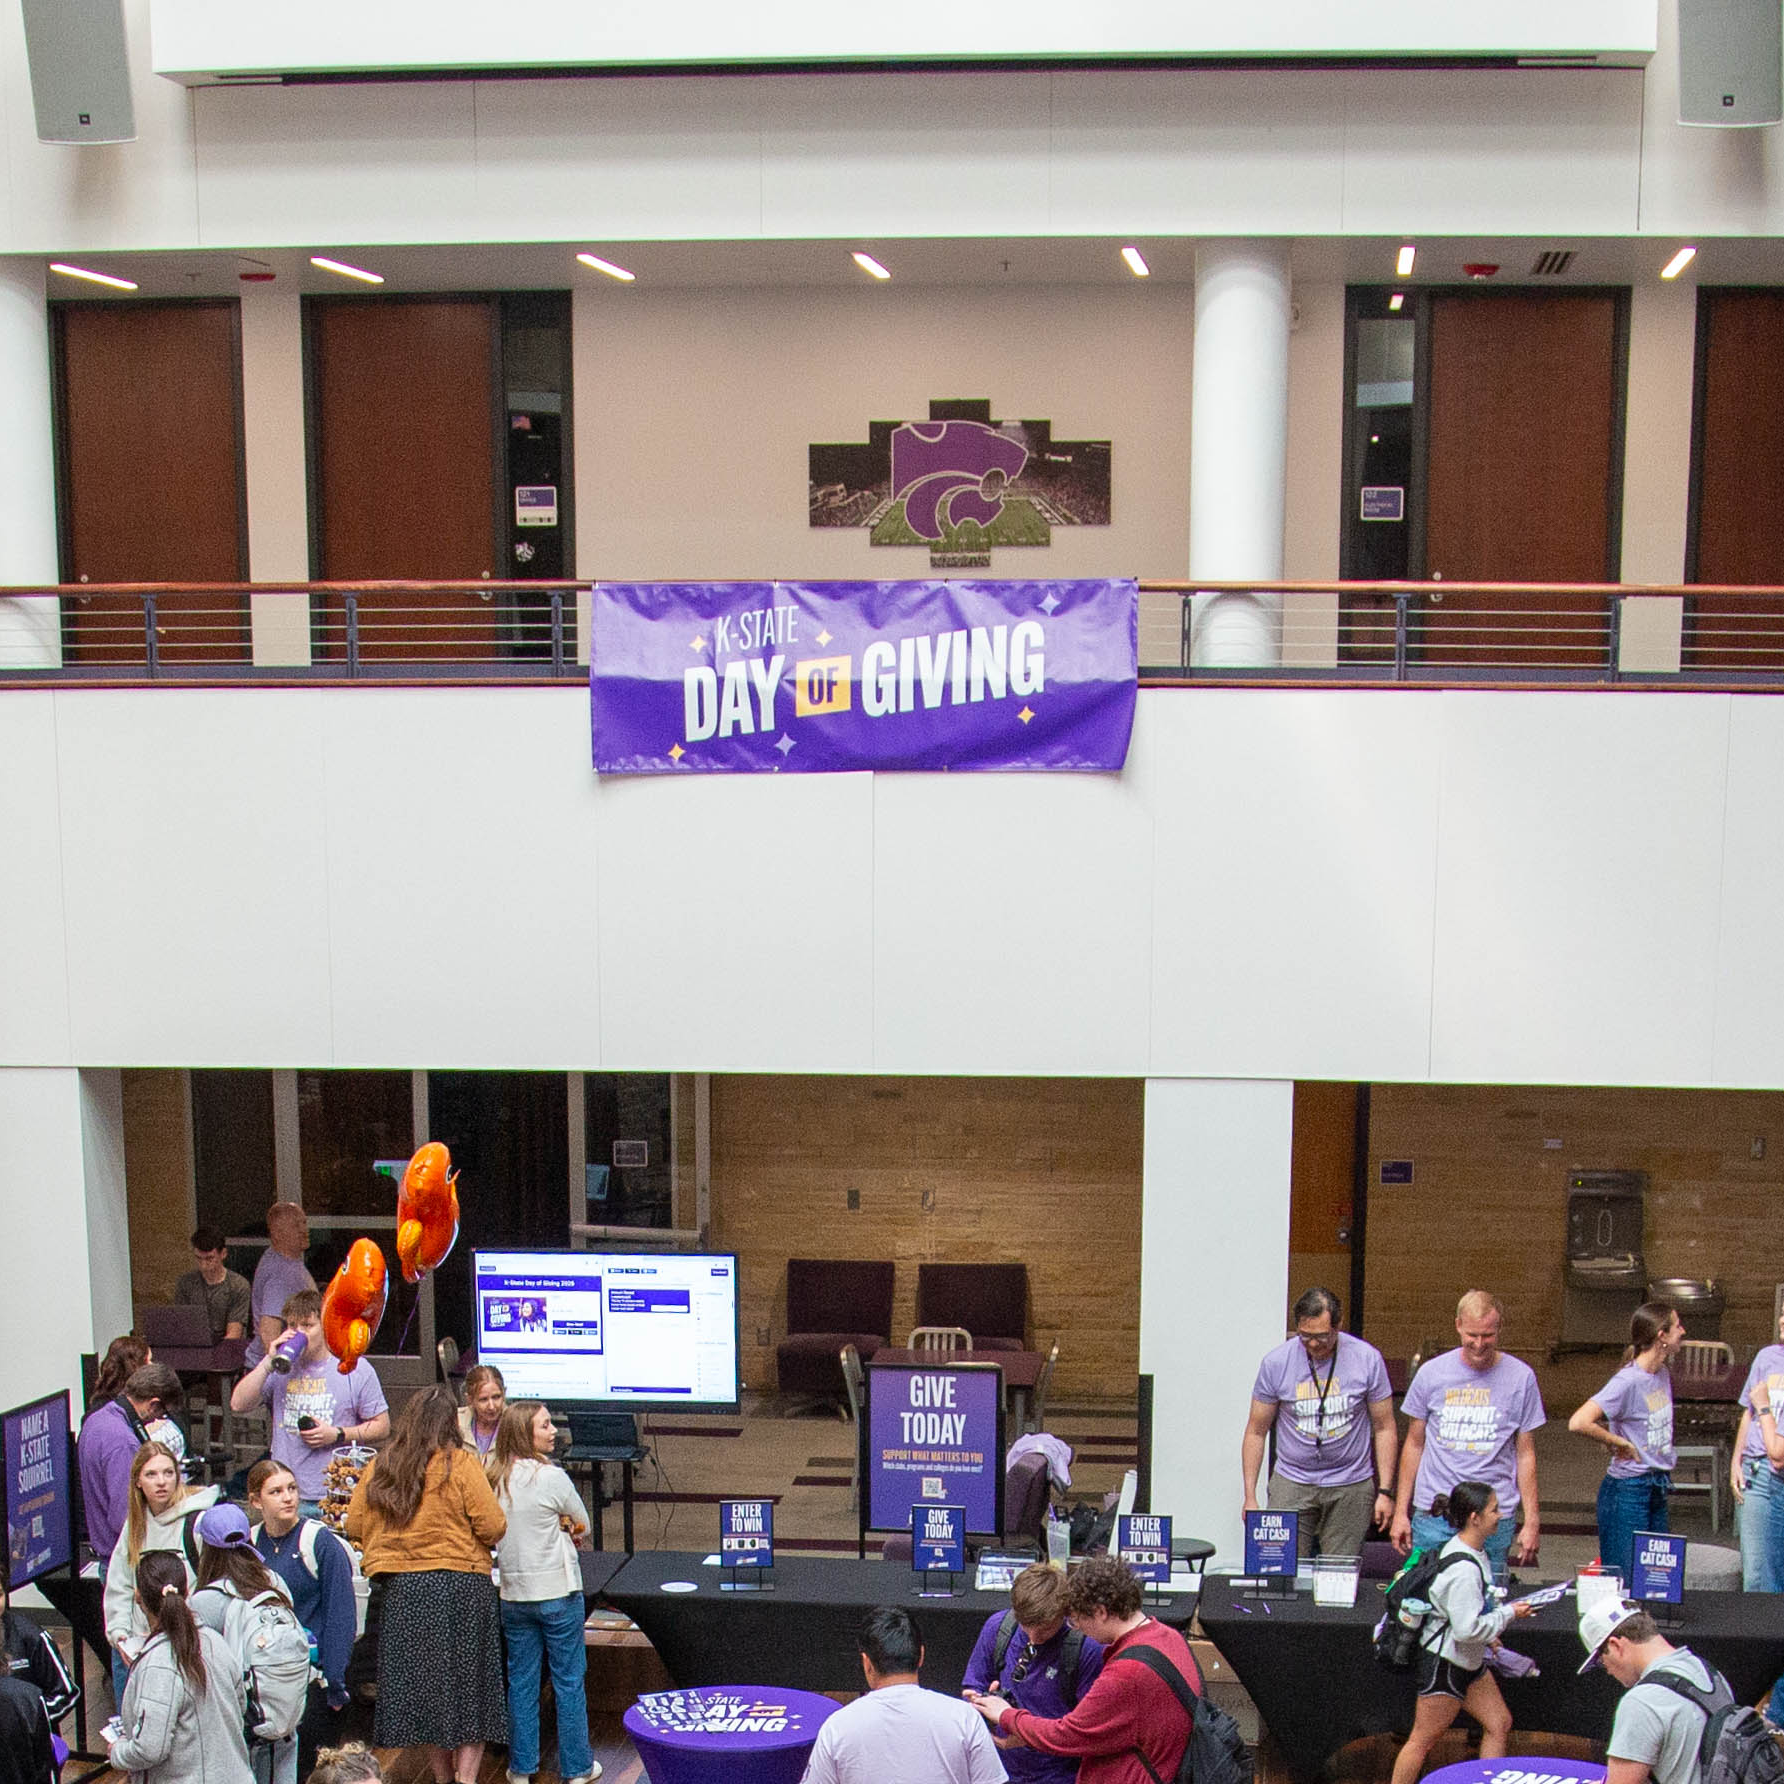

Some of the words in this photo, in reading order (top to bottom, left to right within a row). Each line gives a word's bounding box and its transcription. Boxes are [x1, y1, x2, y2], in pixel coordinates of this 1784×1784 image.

[715, 605, 799, 653] K-STATE
[684, 655, 786, 742] DAY
[807, 666, 839, 706] OF
[861, 620, 1046, 718] GIVING
[910, 1375, 957, 1408] GIVE
[1445, 1387, 1491, 1406] WILDCATS
[1294, 1394, 1349, 1417] SUPORT
[1441, 1406, 1496, 1424] SUPPORT
[21, 1414, 41, 1441] NAME
[41, 1410, 49, 1433] A
[900, 1412, 966, 1445] TODAY
[1438, 1423, 1499, 1441] WILDCATS
[20, 1434, 51, 1467] K-STATE
[883, 1449, 911, 1460] SUPPORT
[912, 1451, 930, 1461] WHAT
[931, 1451, 961, 1463] MATTERS
[962, 1453, 970, 1463] TO
[971, 1452, 984, 1464] YOU
[18, 1459, 55, 1494] SQUIRREL
[732, 1503, 763, 1518] ENTER
[928, 1509, 950, 1524] GIVE
[730, 1517, 743, 1533] TO
[743, 1517, 763, 1533] WIN
[1130, 1517, 1161, 1532] ENTER
[1261, 1515, 1283, 1528] EARN
[924, 1523, 954, 1539] TODAY
[1129, 1531, 1142, 1546] TO
[1142, 1531, 1161, 1546] WIN
[1253, 1528, 1268, 1541] CAT
[1269, 1528, 1291, 1541] CASH
[1648, 1538, 1670, 1552] EARN
[1640, 1551, 1656, 1566] CAT
[1656, 1552, 1677, 1568] CASH
[706, 1696, 744, 1705] STATE
[705, 1704, 751, 1719] AY
